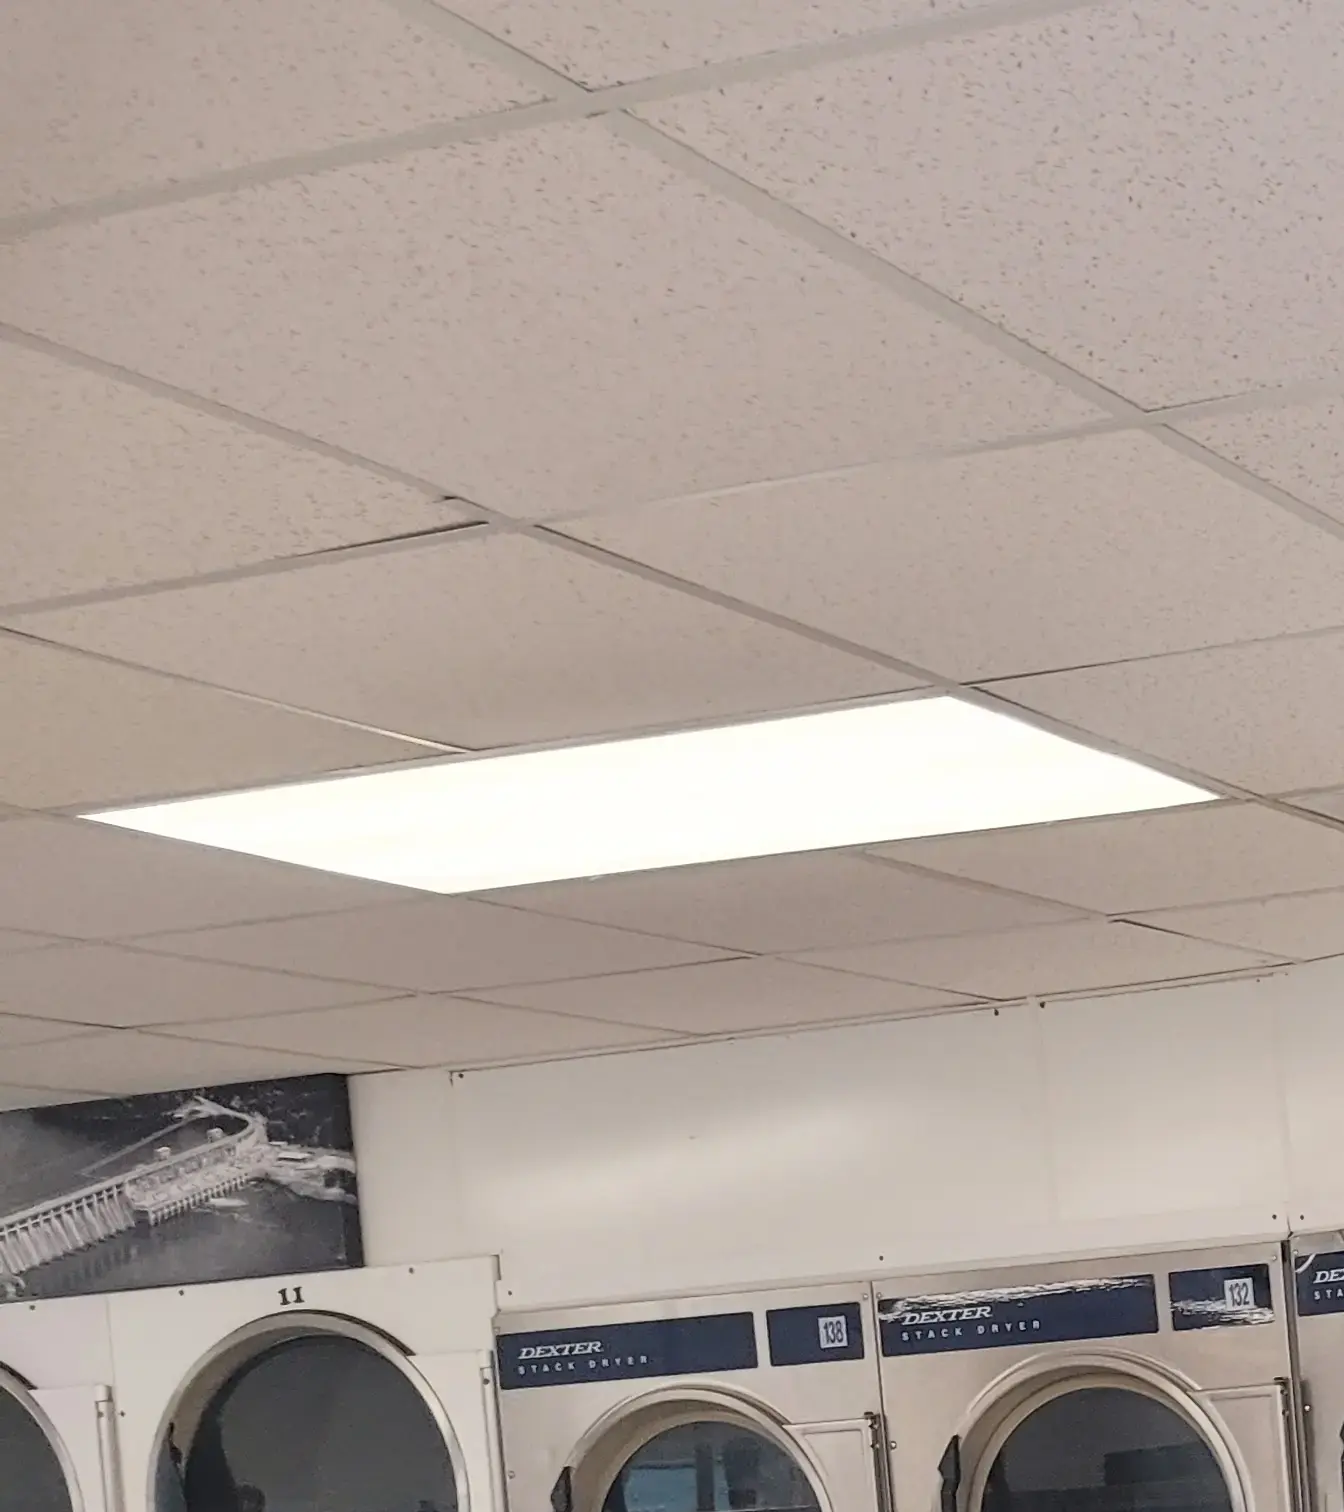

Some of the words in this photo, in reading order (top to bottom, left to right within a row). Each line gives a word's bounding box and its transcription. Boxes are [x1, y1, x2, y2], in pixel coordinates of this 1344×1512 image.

[278, 1286, 305, 1306] 11
[901, 1306, 993, 1326] DEXTER
[823, 1320, 844, 1344] 138
[901, 1327, 963, 1342] STACK
[977, 1320, 1041, 1335] DRYER
[518, 1341, 603, 1360] DEXTER
[518, 1361, 577, 1376] STACK
[588, 1355, 649, 1370] DRYER
